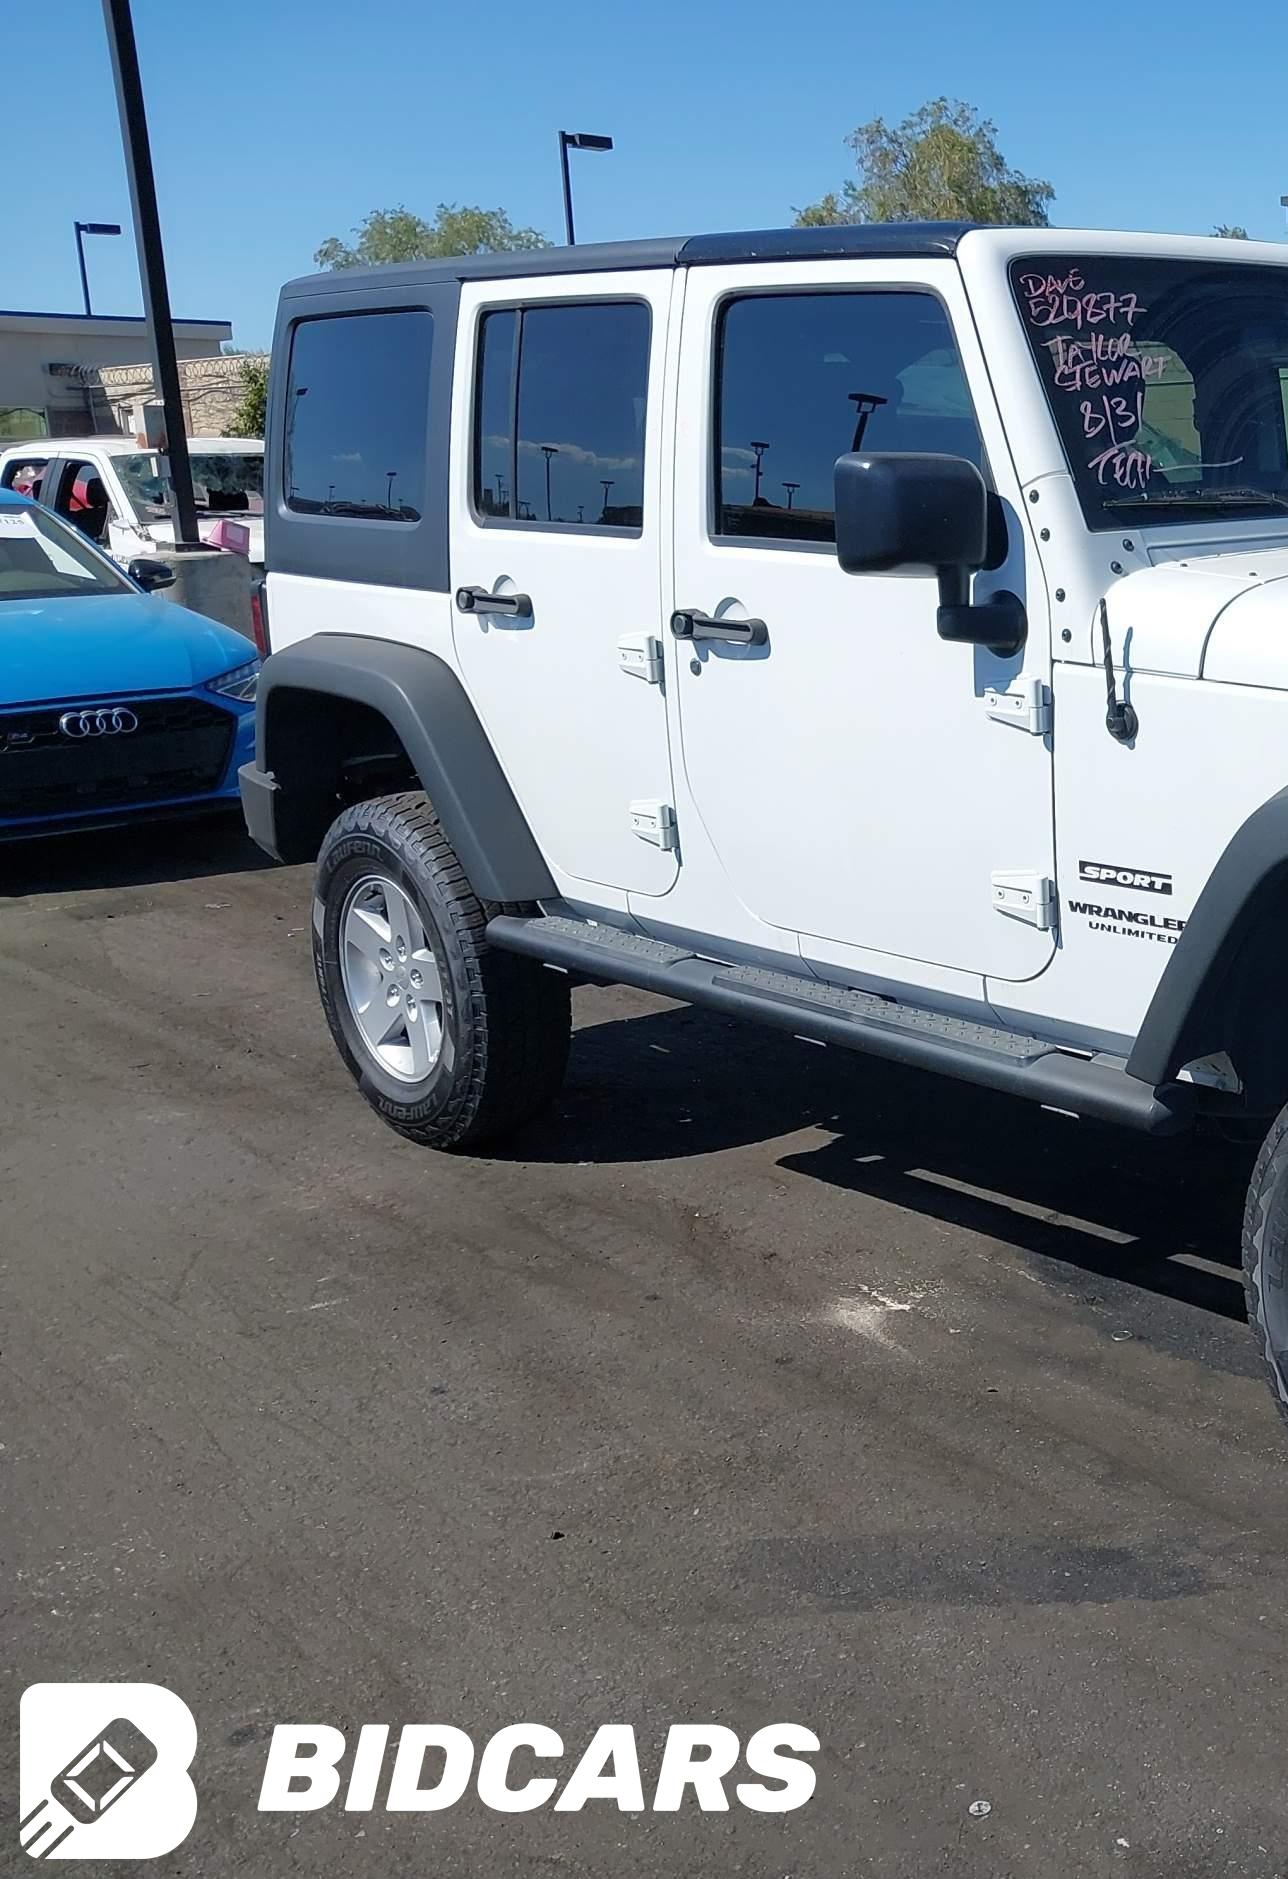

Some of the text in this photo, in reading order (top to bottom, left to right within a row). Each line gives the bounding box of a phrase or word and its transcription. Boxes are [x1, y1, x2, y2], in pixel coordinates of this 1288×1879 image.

[1020, 268, 1085, 298] DAVE
[1054, 355, 1172, 391] STEWART
[1080, 862, 1172, 893] SPORT
[1088, 921, 1179, 944] UNLIMITED
